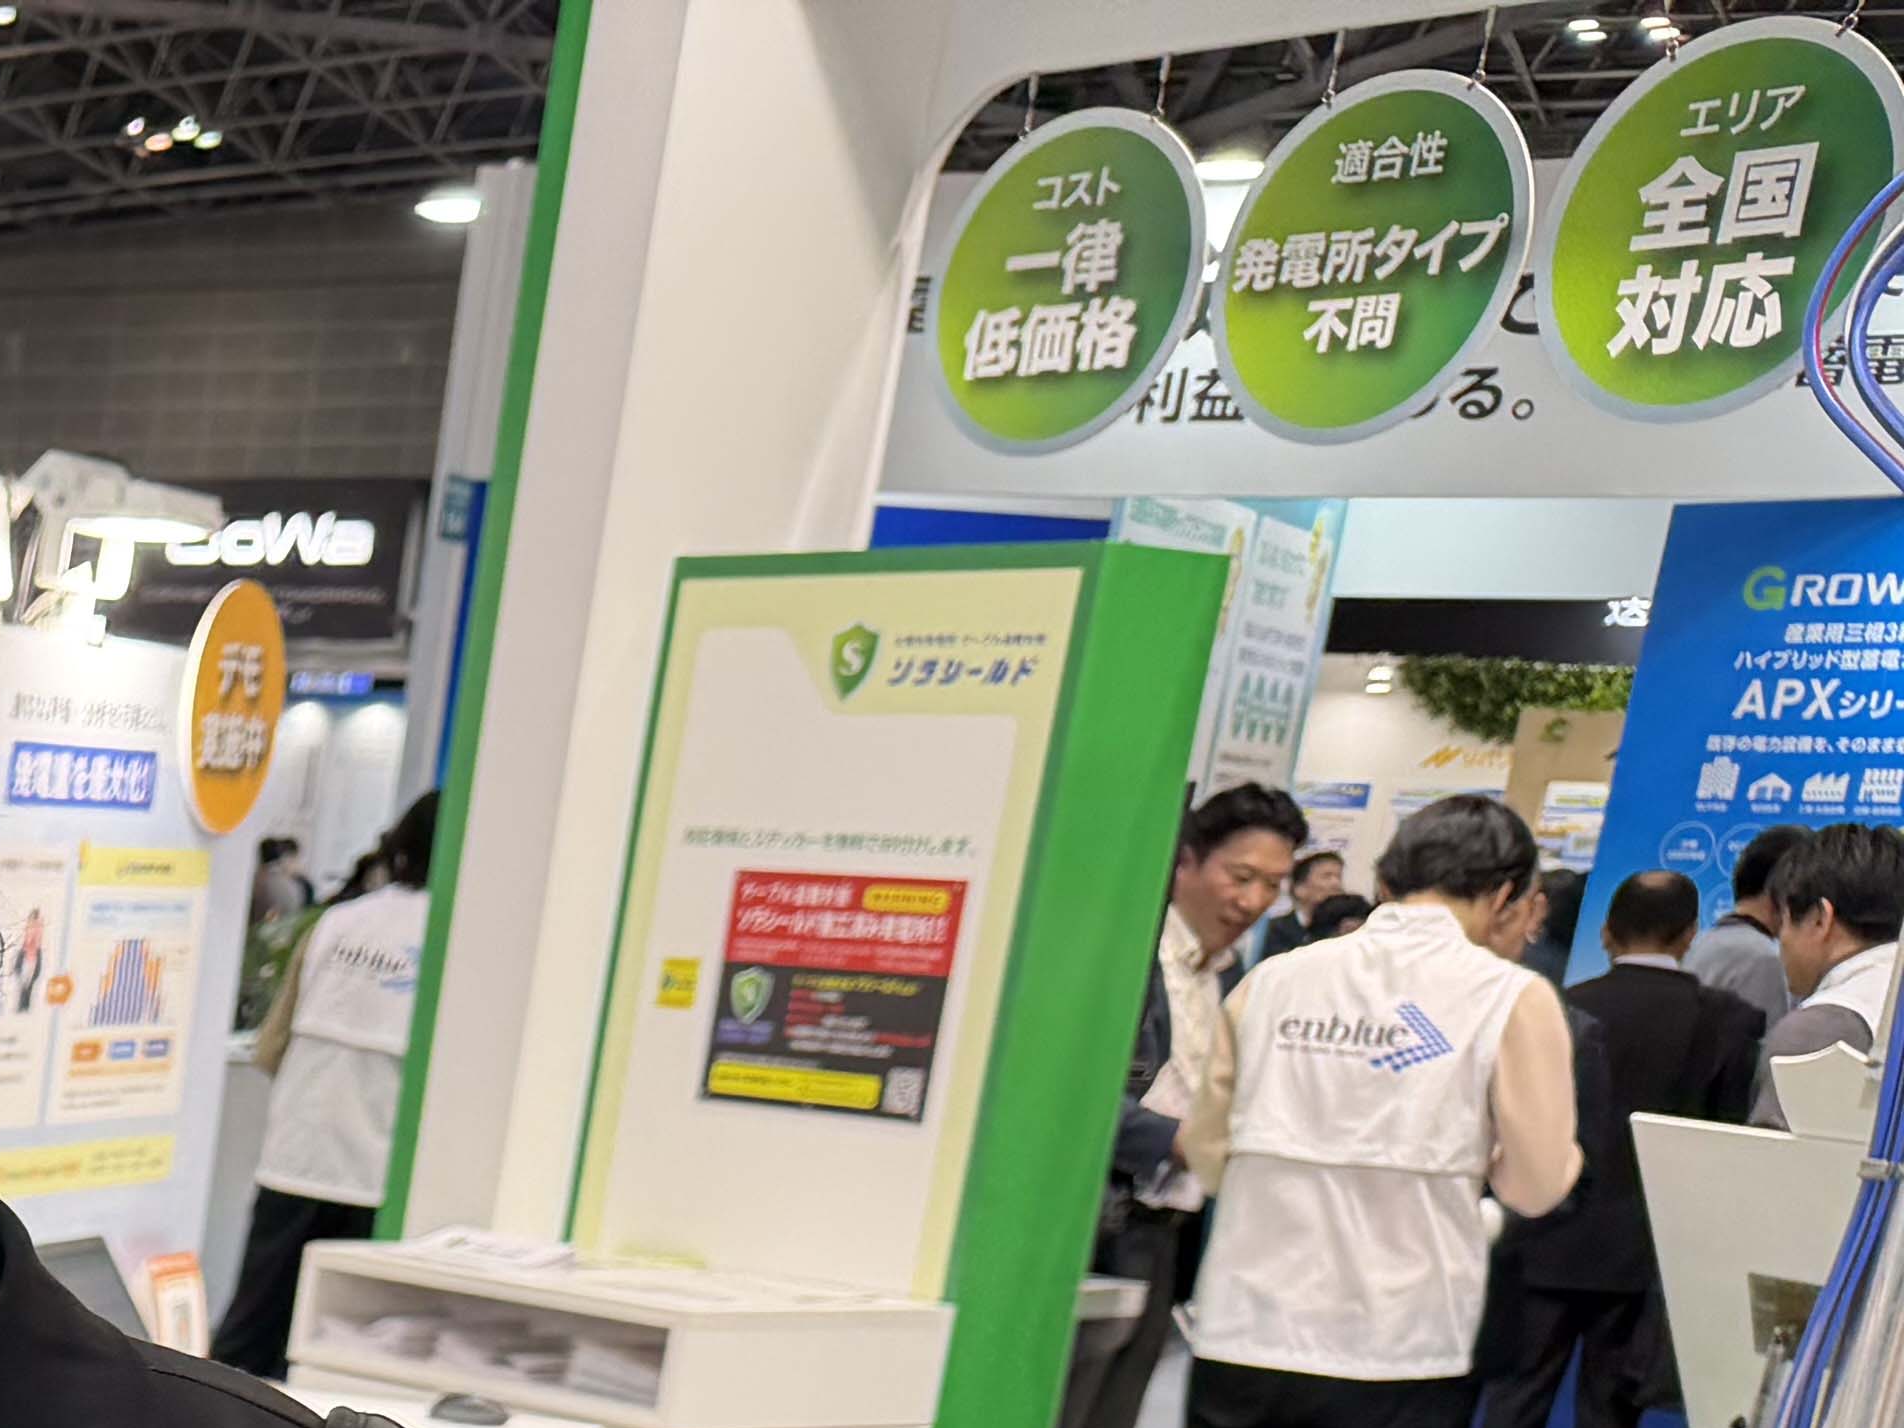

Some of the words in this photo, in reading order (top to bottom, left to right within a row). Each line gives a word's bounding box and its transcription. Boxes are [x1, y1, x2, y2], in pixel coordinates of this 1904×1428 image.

[1679, 84, 1807, 137] エリア
[1331, 130, 1448, 184] 適合性
[1033, 165, 1122, 210] コスト
[1629, 140, 1821, 252] 全国
[1005, 217, 1124, 294] 一律
[1232, 212, 1510, 294] 発電所タイプ
[1303, 291, 1402, 355] 不問
[1606, 252, 1796, 359] 対応
[963, 296, 1140, 381] 低価格
[1732, 648, 1904, 672] ハイブリッド型蓄電
[1730, 677, 1904, 722] APXシリ
[1279, 1012, 1409, 1049] enblue
